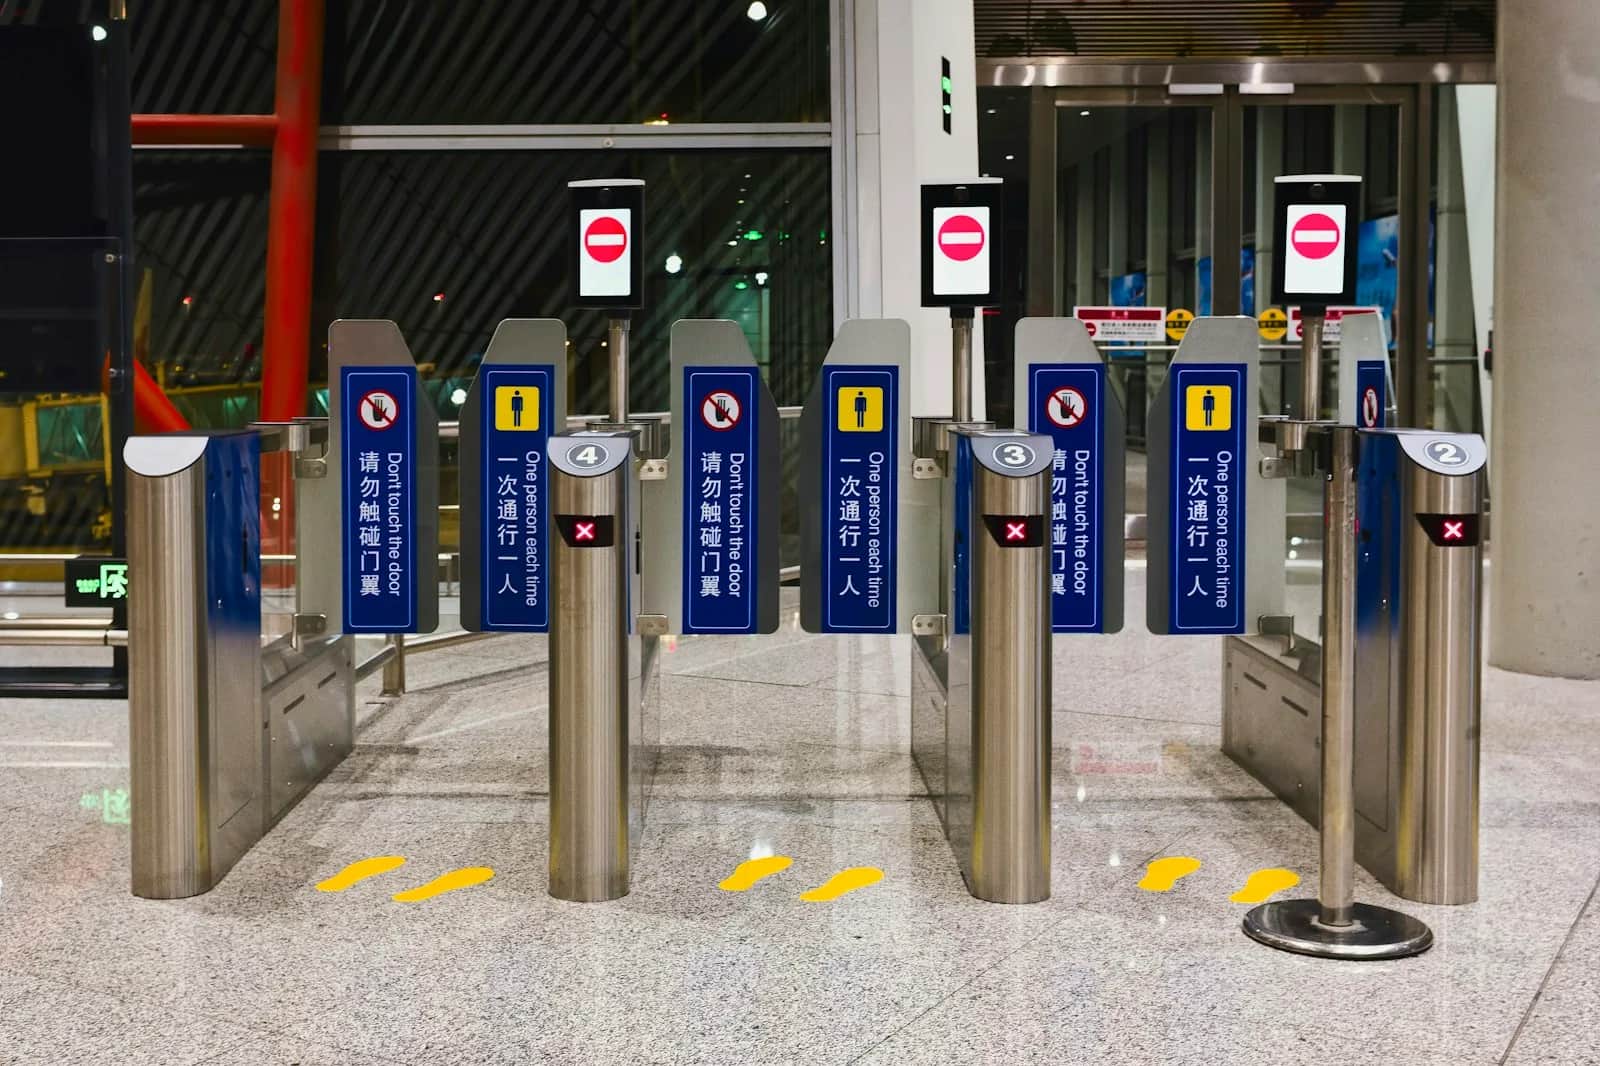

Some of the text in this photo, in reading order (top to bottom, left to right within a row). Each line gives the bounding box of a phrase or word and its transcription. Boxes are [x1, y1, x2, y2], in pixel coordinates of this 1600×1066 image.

[575, 446, 599, 465] 4
[1003, 445, 1026, 465] 3
[1435, 443, 1461, 462] 2
[358, 451, 381, 595] 请勿触碰门翼
[387, 493, 402, 532] touch
[497, 458, 519, 593] 一次通行一人
[522, 451, 540, 606] One person each time
[700, 452, 722, 596] 请勿触碰门翼
[729, 494, 743, 533] touch
[839, 459, 862, 595] 一次通行一人
[865, 452, 884, 607] One person each time
[1074, 491, 1089, 531] touch
[1187, 458, 1209, 596] 一次通行一人
[1213, 451, 1232, 608] One person each time
[388, 537, 402, 559] the
[729, 537, 743, 560] the
[1074, 535, 1088, 557] the
[388, 563, 402, 596] door
[728, 564, 743, 597] door
[1073, 561, 1088, 595] door
